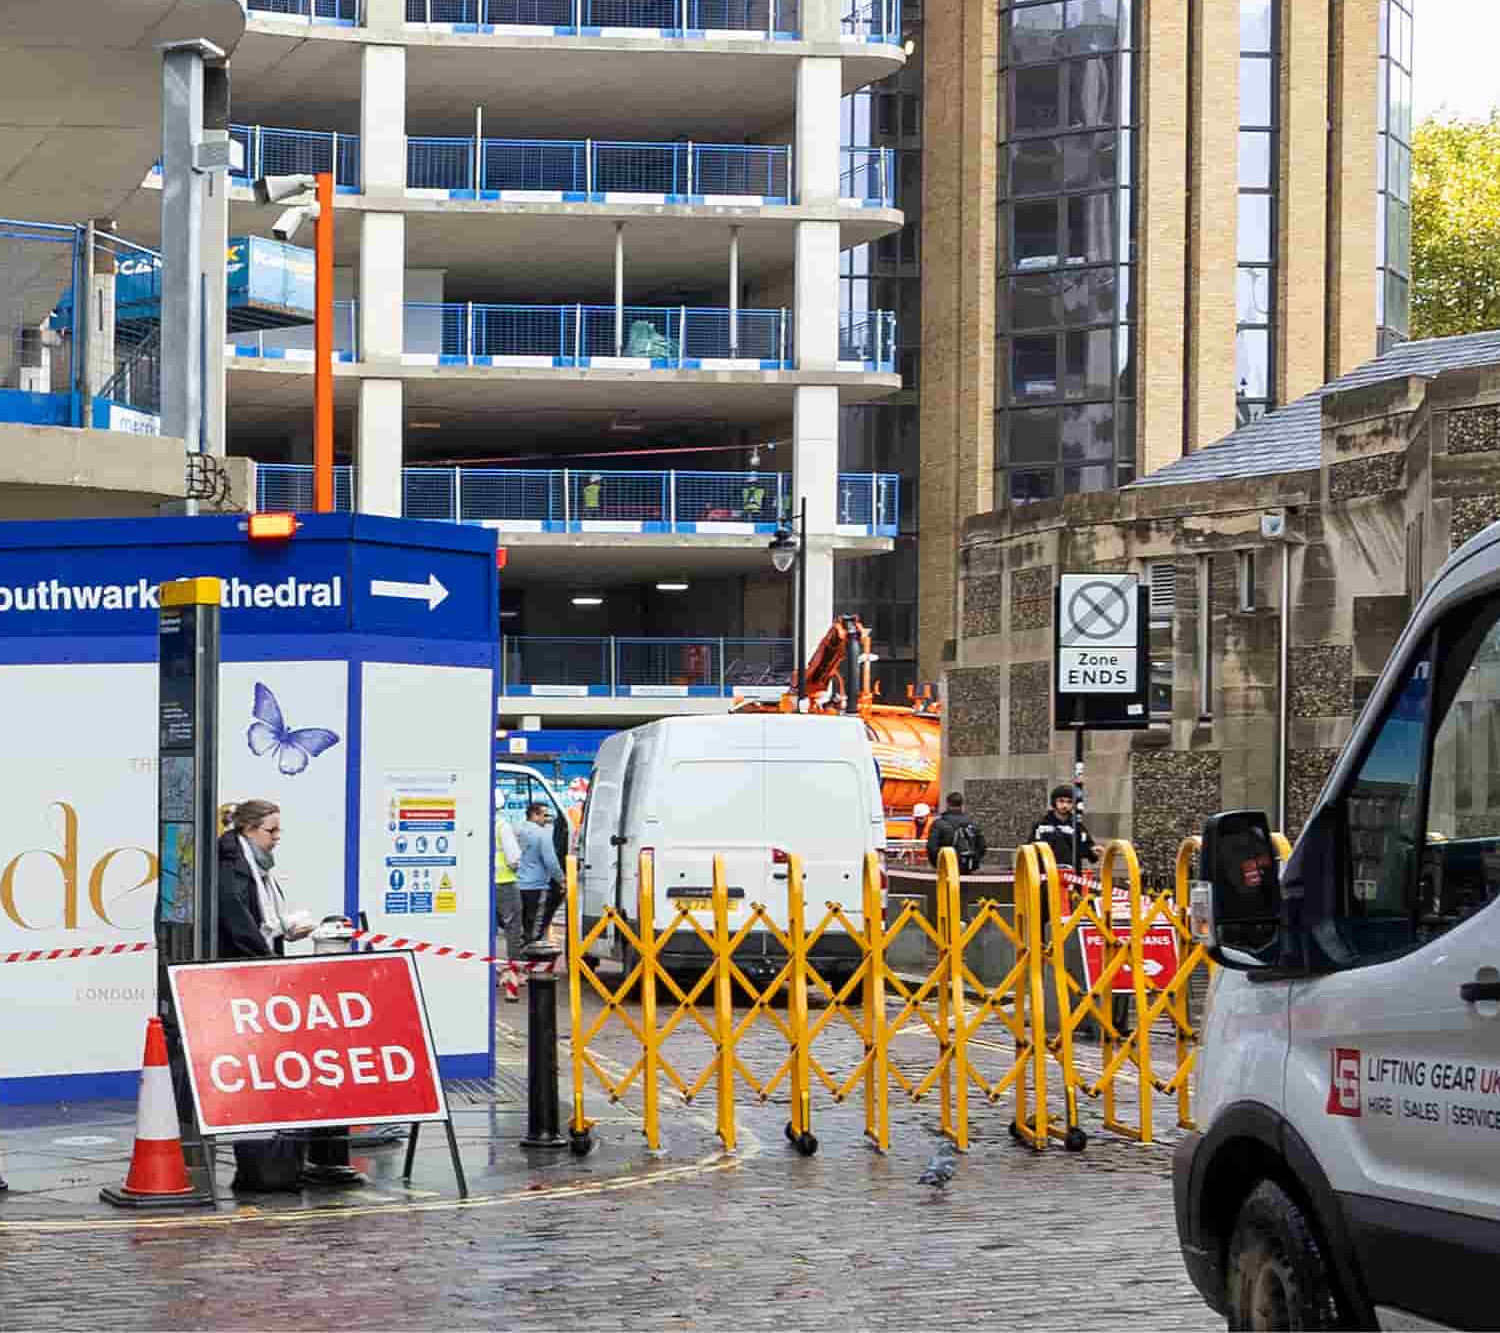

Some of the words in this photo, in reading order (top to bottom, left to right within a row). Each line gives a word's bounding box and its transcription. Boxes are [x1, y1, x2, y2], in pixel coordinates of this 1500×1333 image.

[176, 575, 341, 608] thedral
[1077, 652, 1118, 666] Zone
[1068, 669, 1128, 686] ENDS
[230, 991, 374, 1035] ROAD
[210, 1044, 416, 1094] CLOSED
[1367, 1057, 1426, 1087] LIFTING
[1430, 1062, 1476, 1092] GEAR
[1367, 1096, 1393, 1116] HIRE
[1403, 1100, 1441, 1123] SALES
